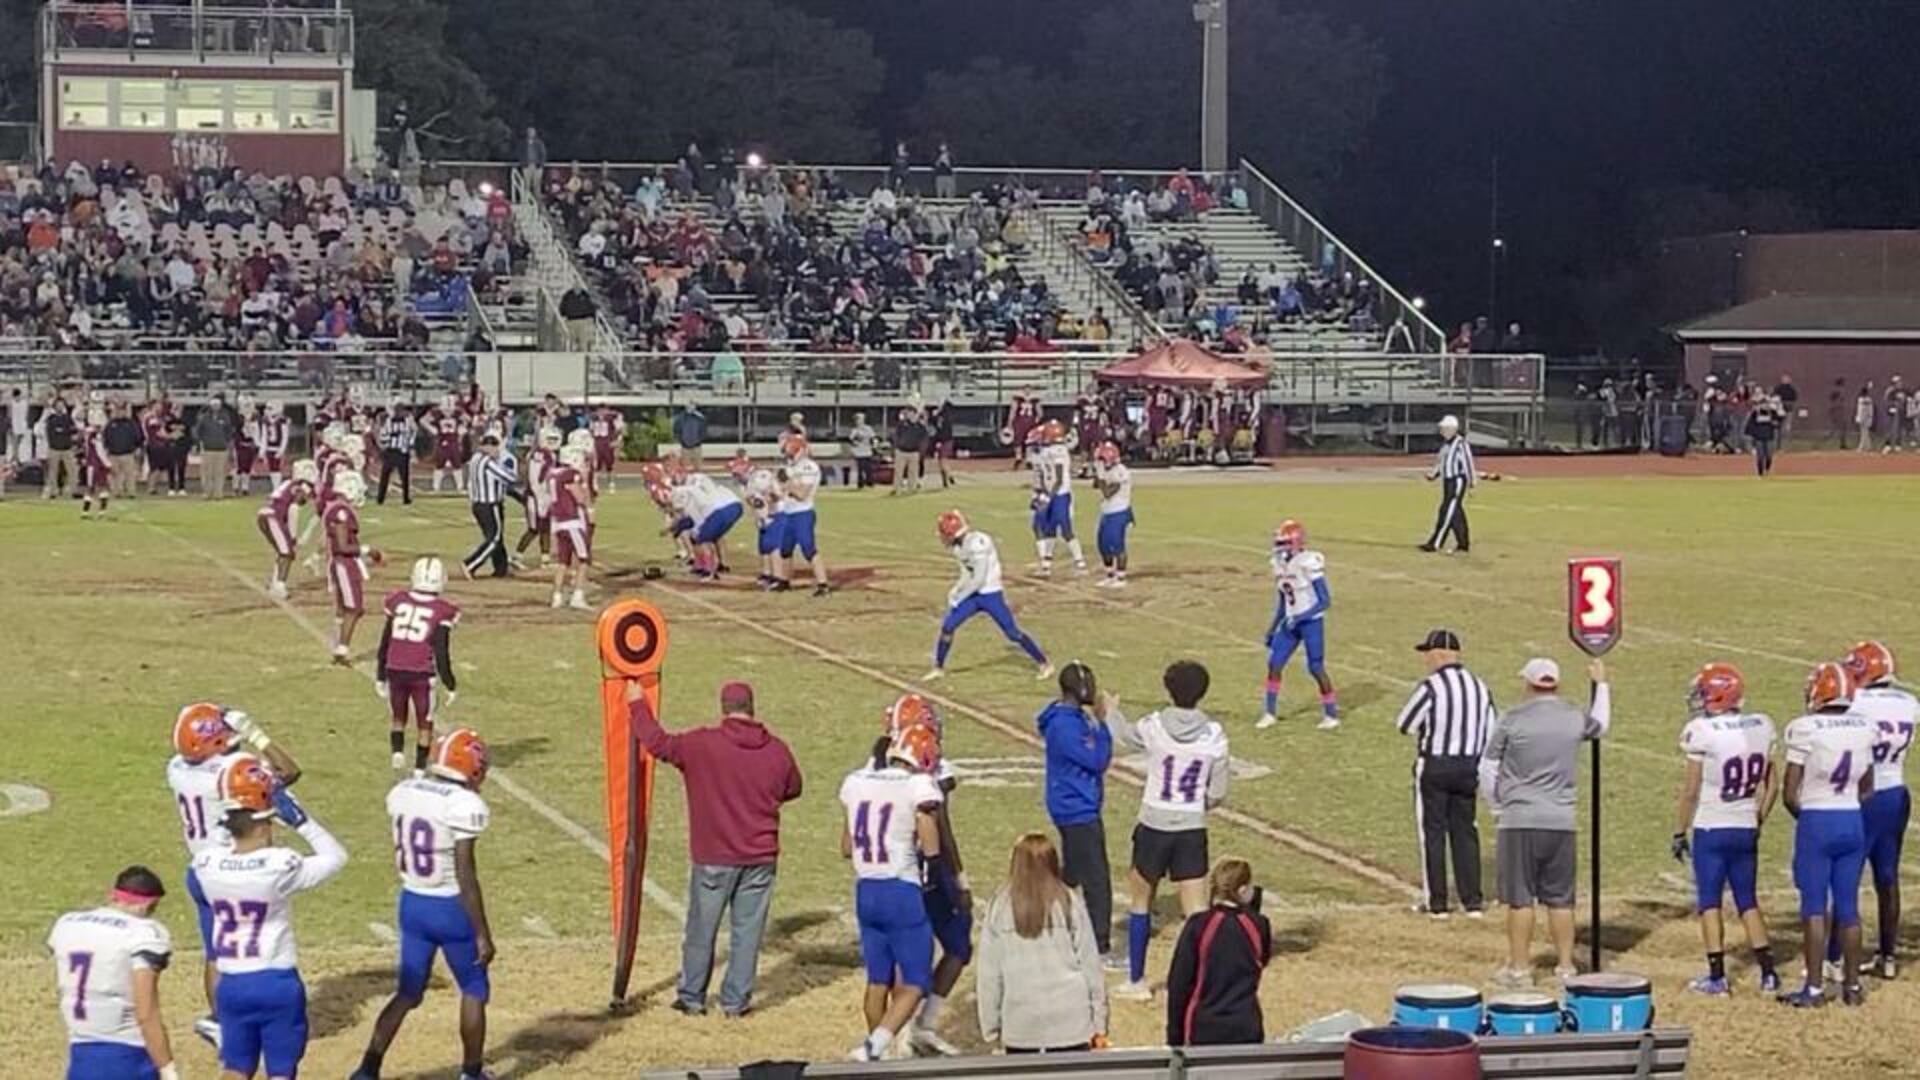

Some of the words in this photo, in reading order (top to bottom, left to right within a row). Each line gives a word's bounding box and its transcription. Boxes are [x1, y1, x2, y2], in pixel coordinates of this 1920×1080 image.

[392, 603, 434, 643] 25
[1580, 566, 1614, 627] 3
[1160, 754, 1203, 803] 14
[1720, 752, 1765, 803] 88
[1829, 750, 1852, 795] 4
[395, 814, 435, 878] 18
[854, 800, 893, 864] 41
[213, 899, 269, 958] 27
[68, 951, 94, 1021] 7
